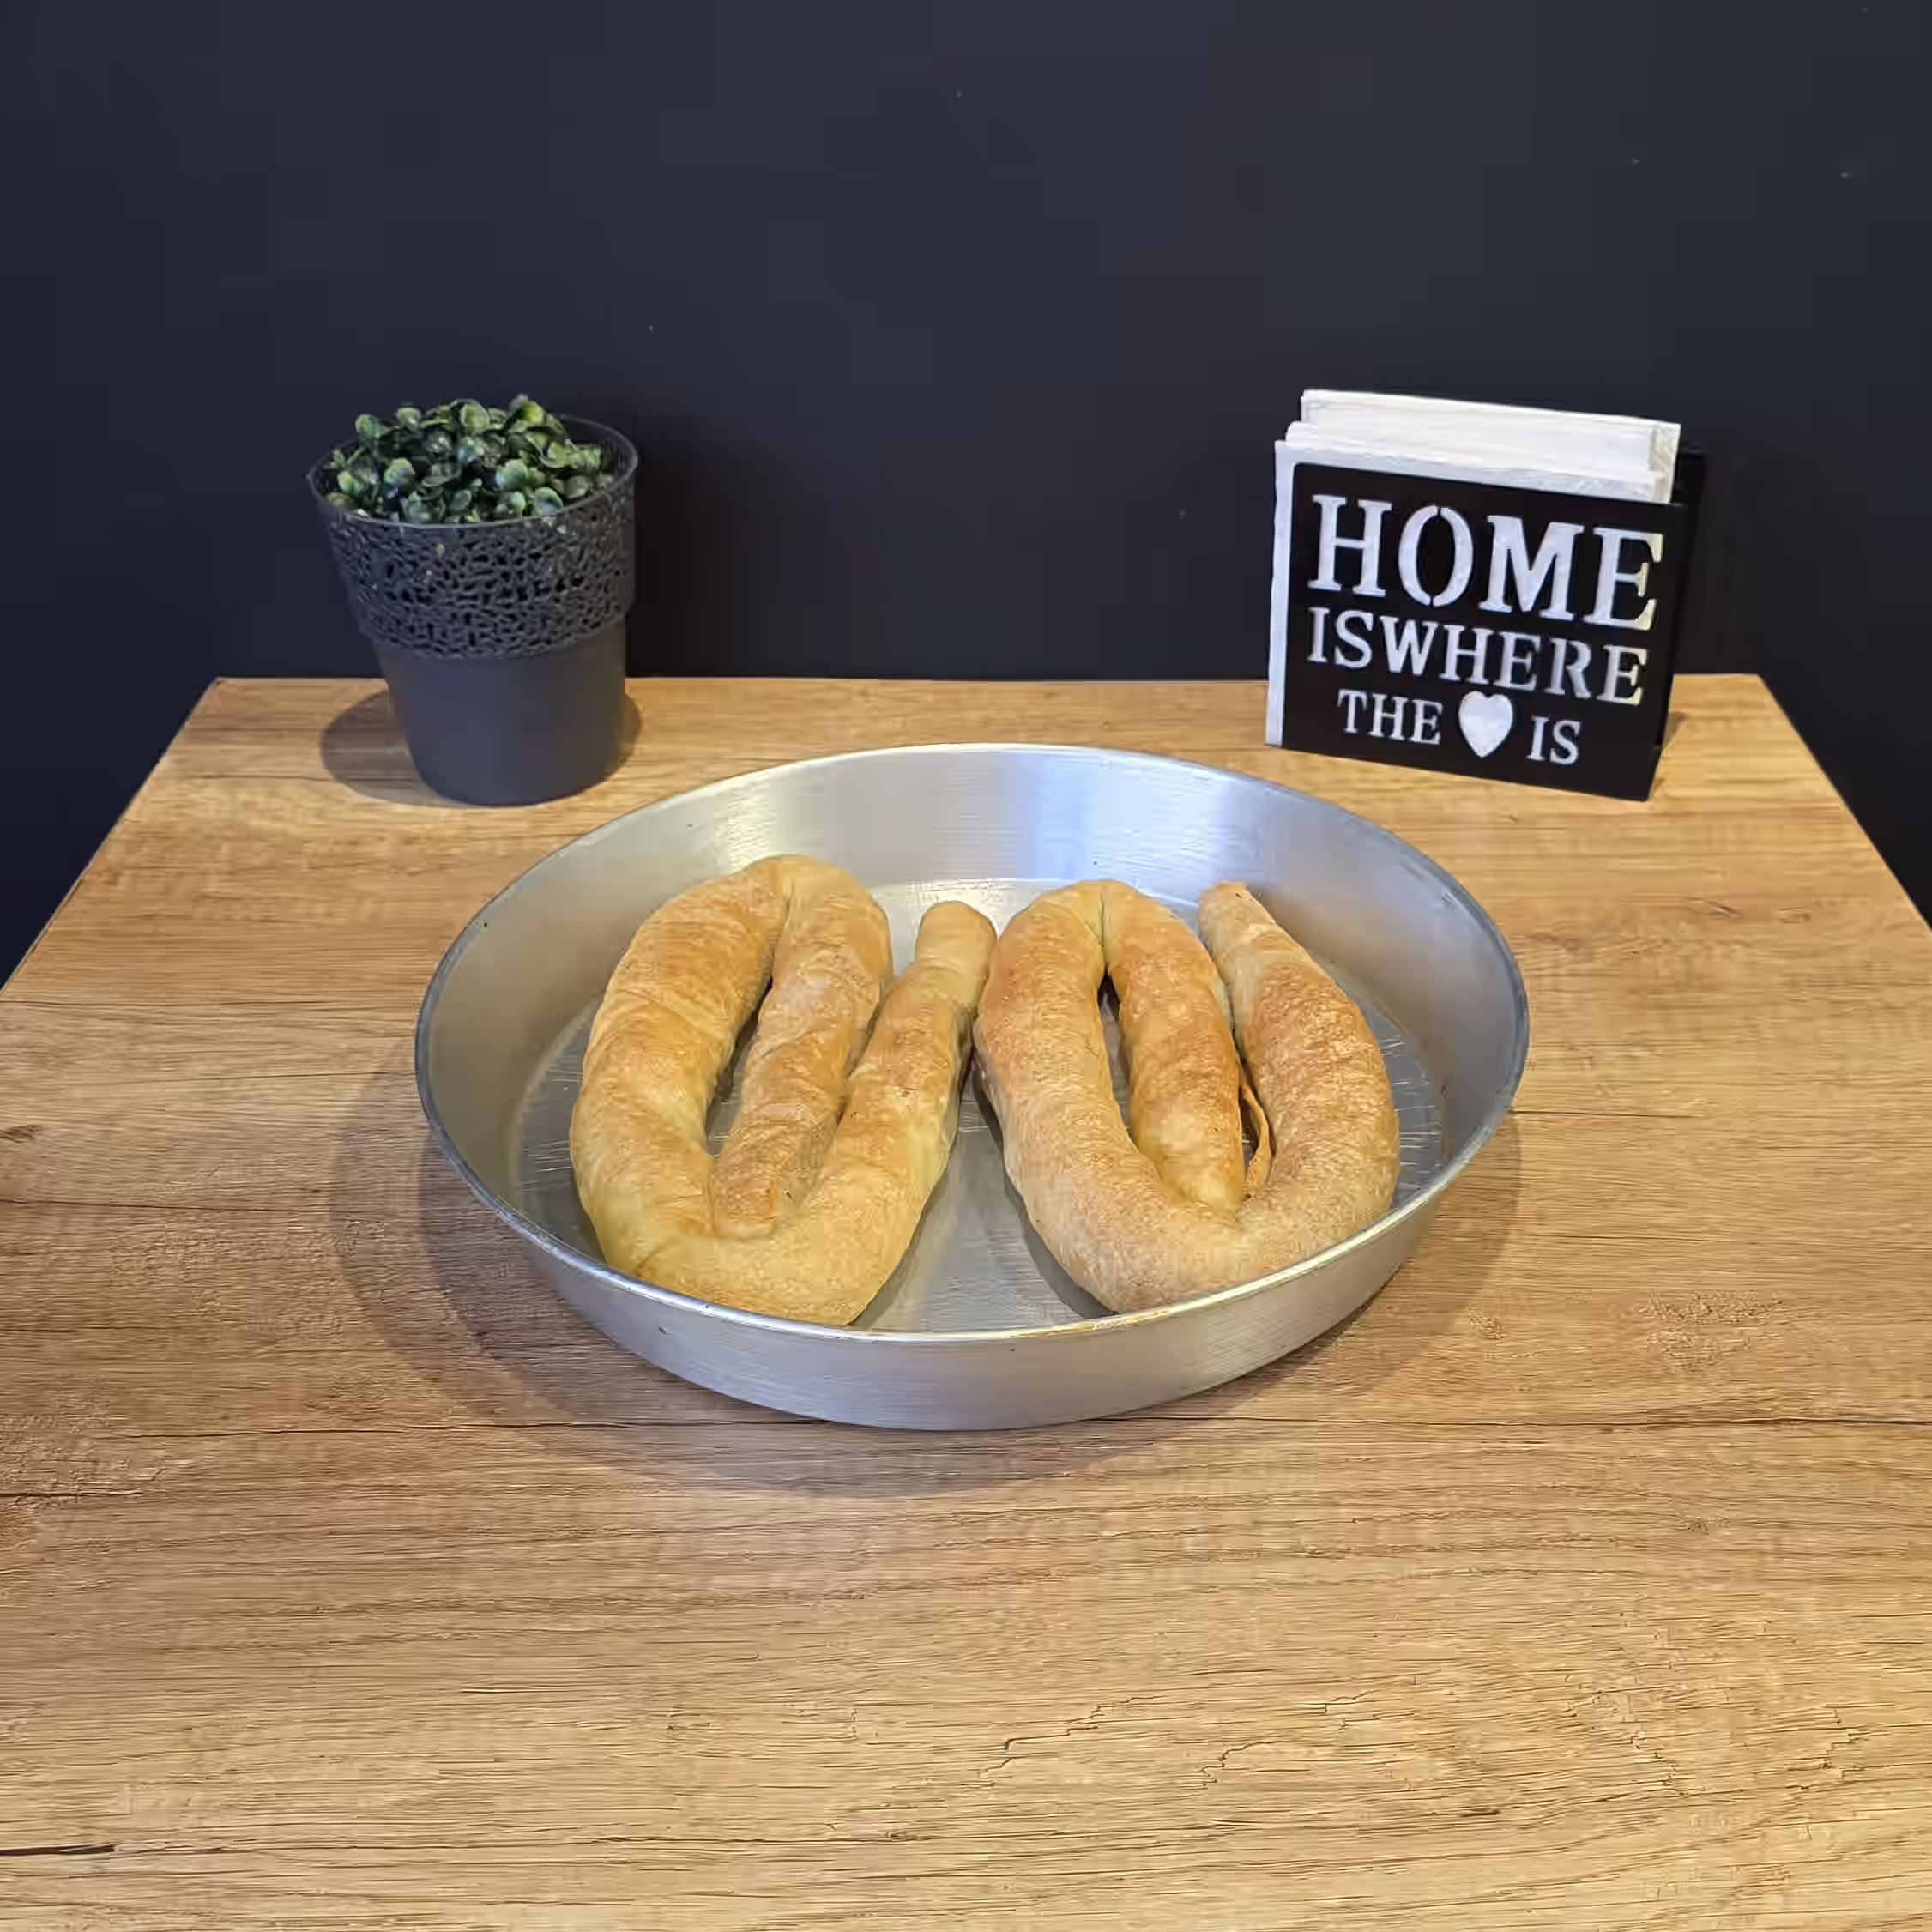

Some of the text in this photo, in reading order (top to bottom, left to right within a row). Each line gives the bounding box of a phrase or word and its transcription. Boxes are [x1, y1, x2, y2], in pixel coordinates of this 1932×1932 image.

[1308, 494, 1663, 631] HOME
[1337, 689, 1581, 765] THE IS
